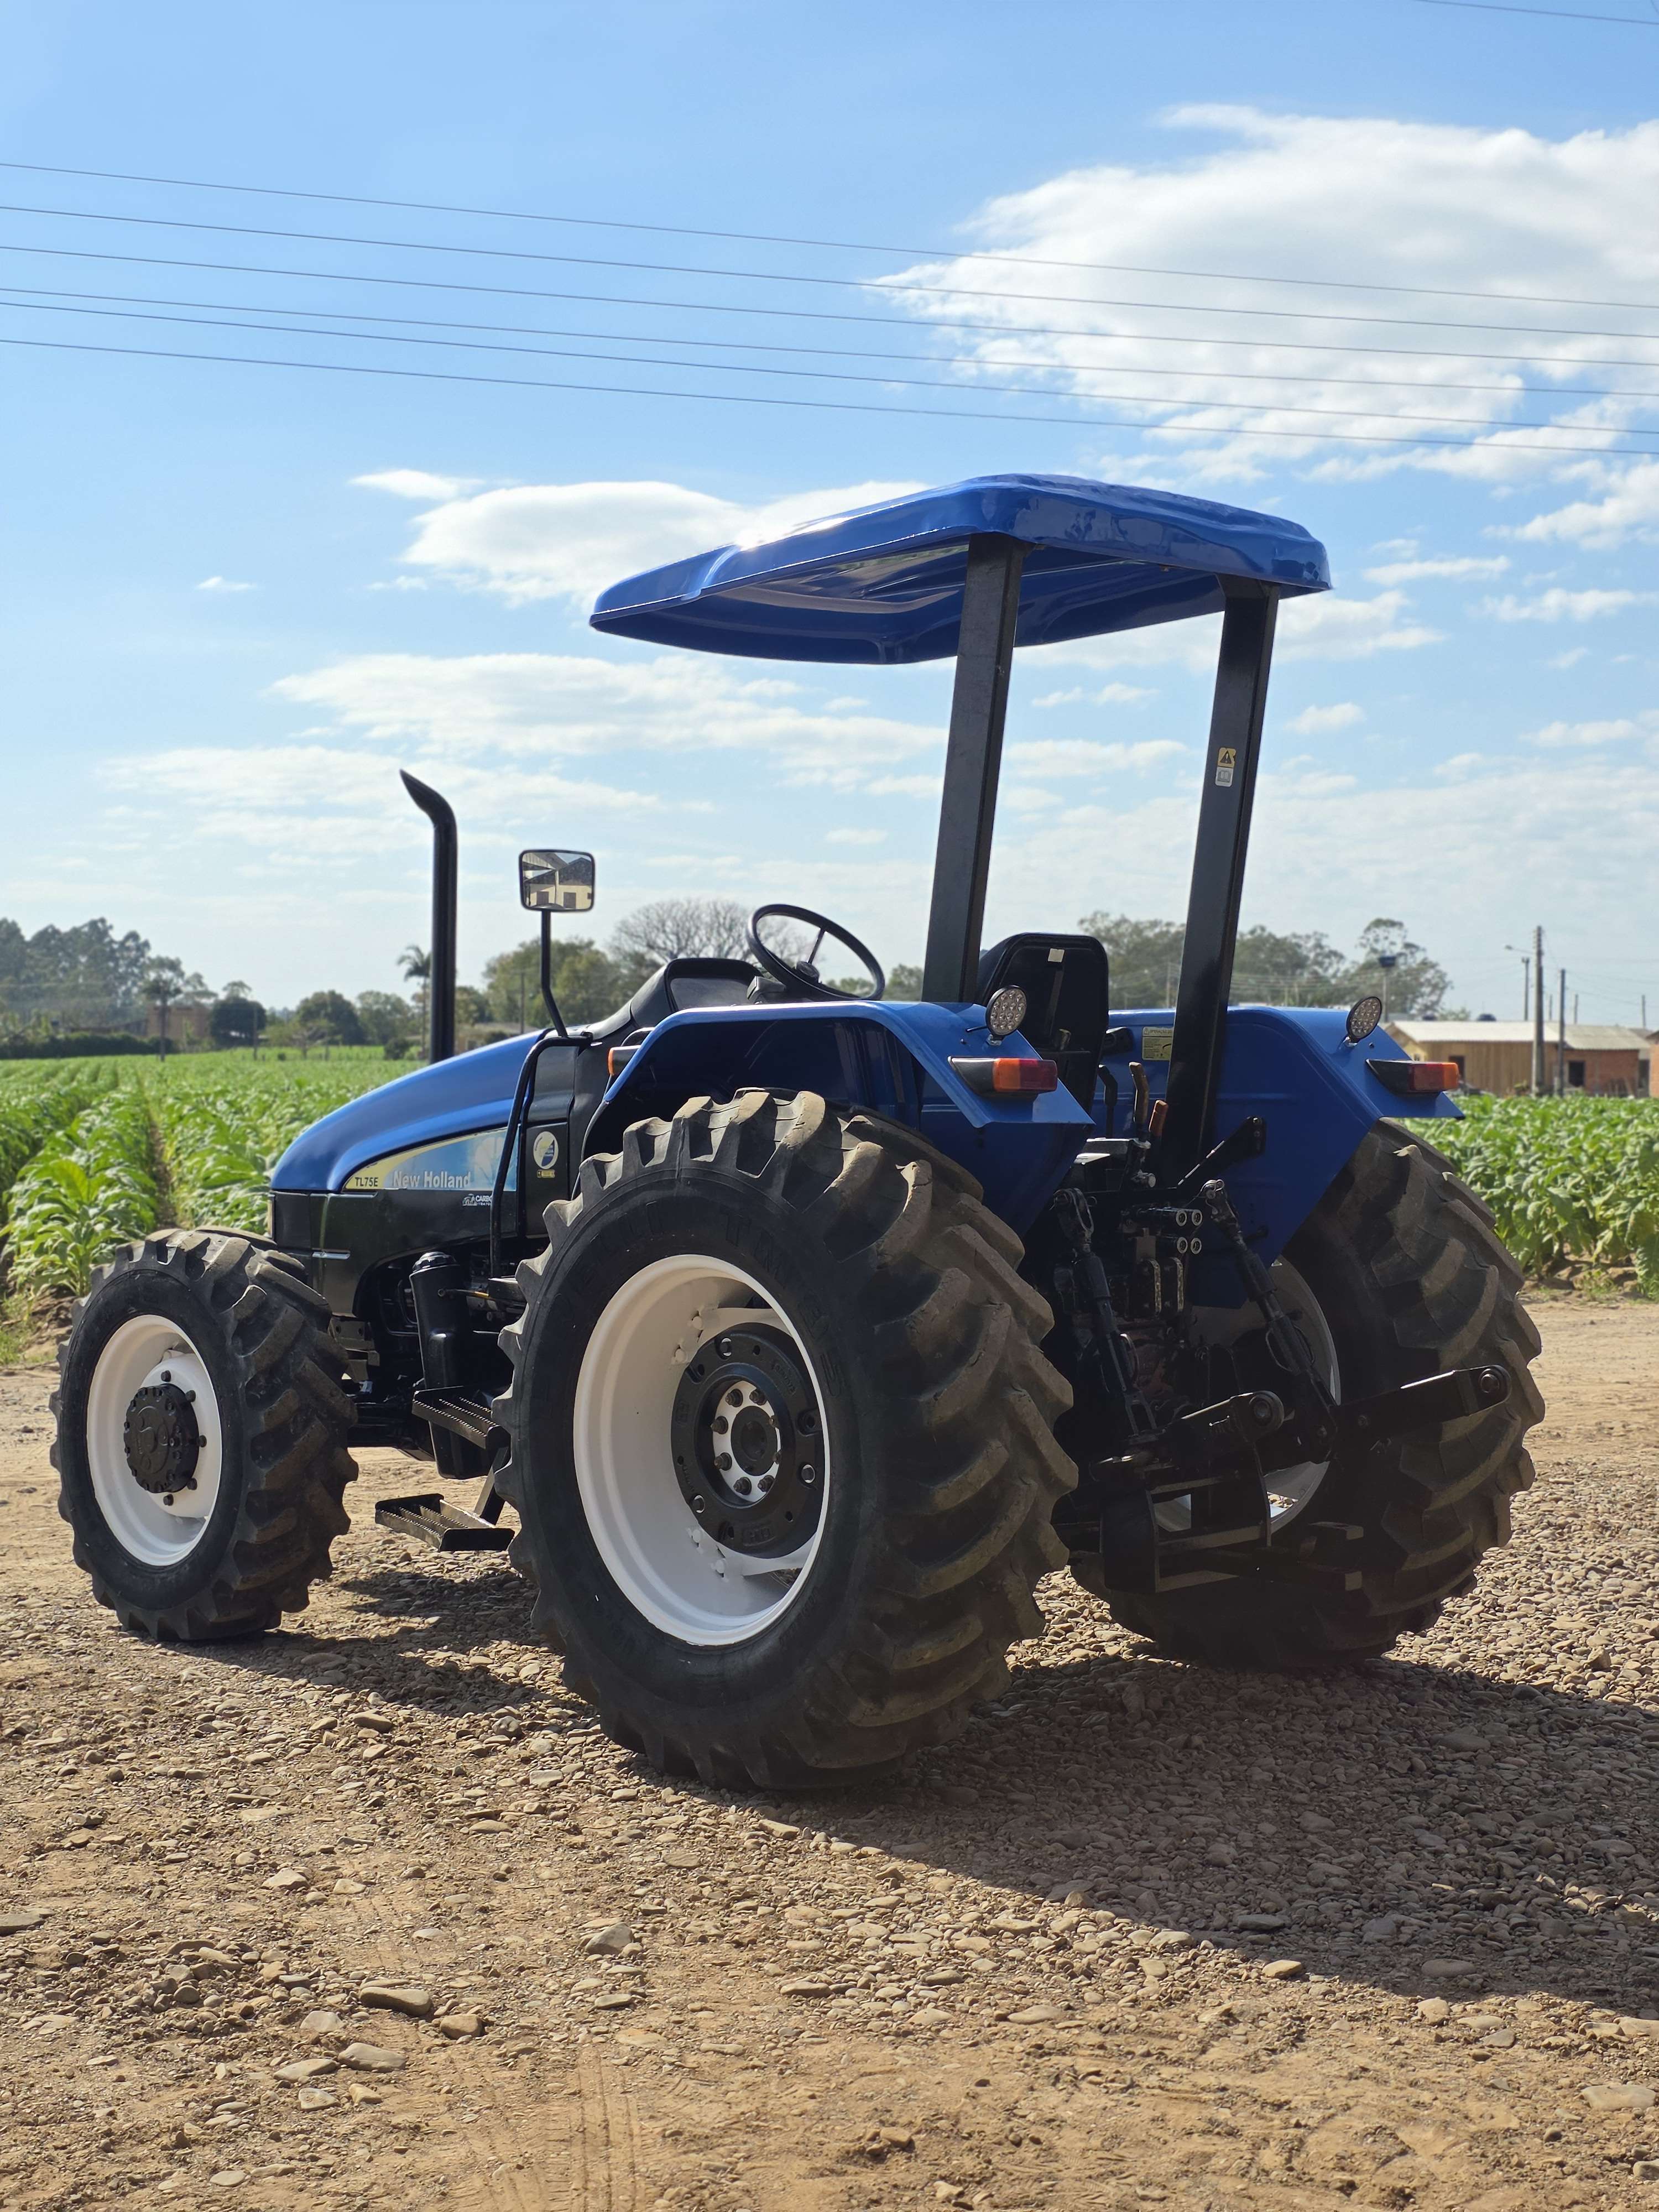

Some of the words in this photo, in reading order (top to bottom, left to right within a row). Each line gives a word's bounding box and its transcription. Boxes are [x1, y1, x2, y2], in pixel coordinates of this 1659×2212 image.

[354, 1177, 378, 1187] TL75E
[393, 1171, 420, 1187] New
[424, 1171, 469, 1188] Holland
